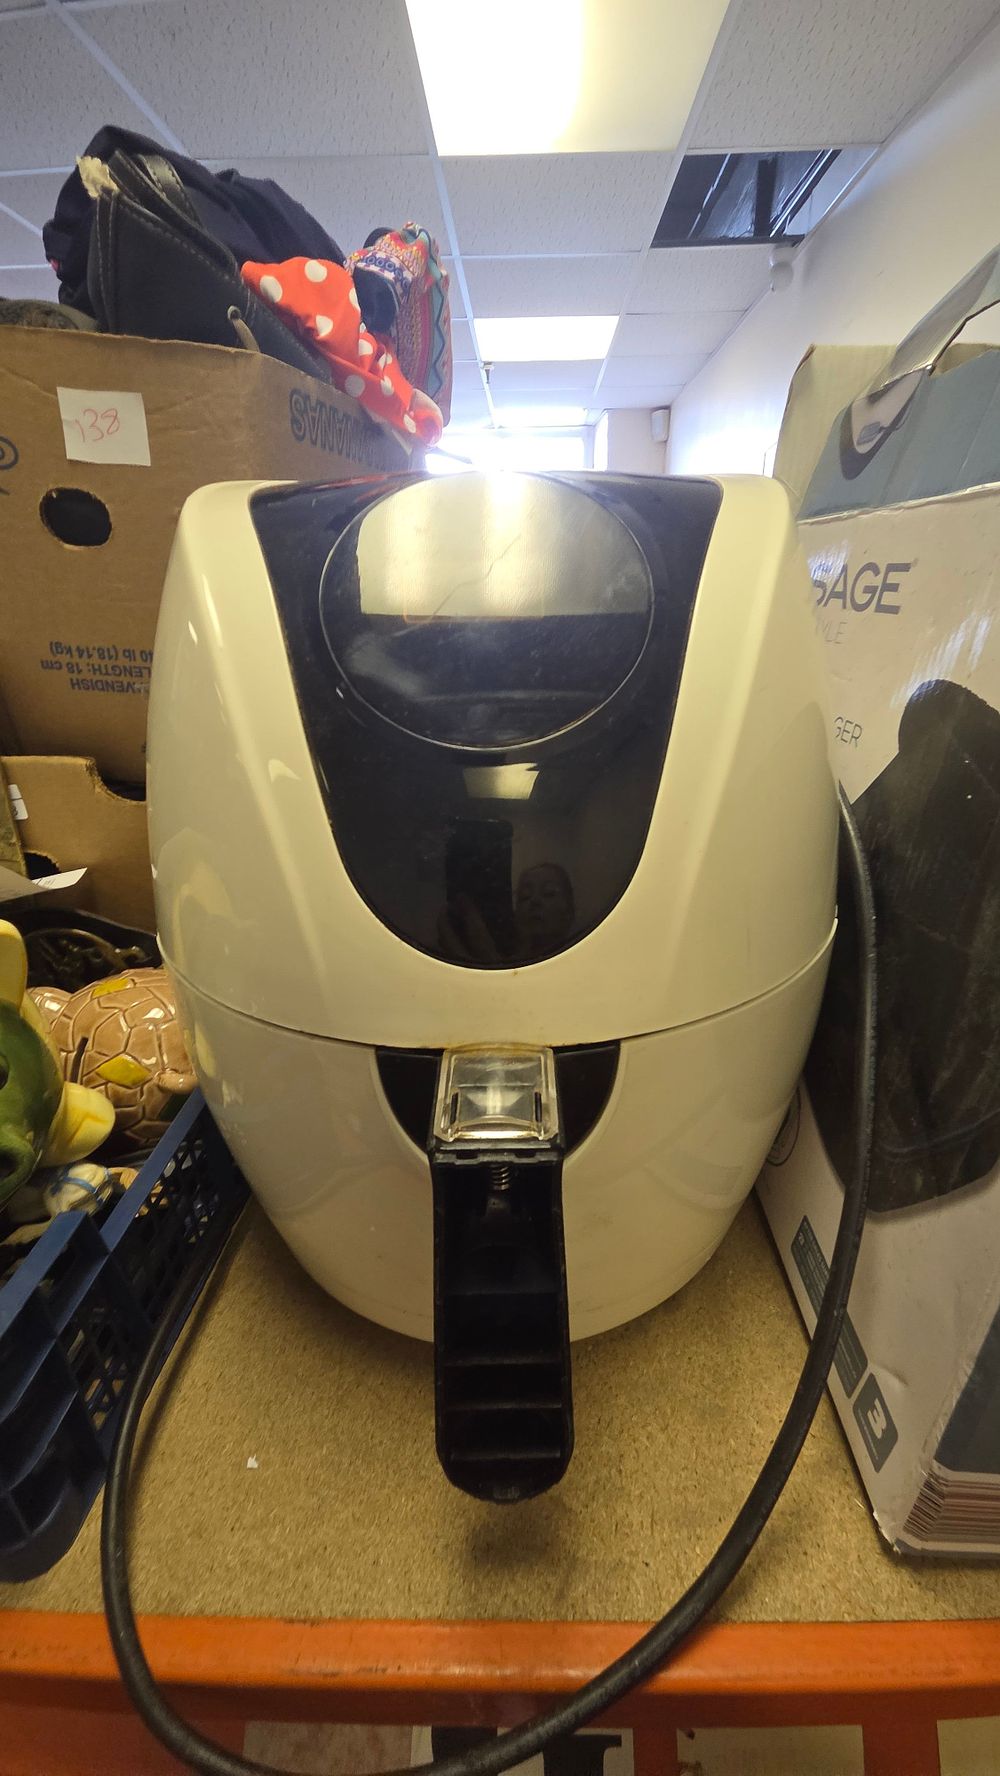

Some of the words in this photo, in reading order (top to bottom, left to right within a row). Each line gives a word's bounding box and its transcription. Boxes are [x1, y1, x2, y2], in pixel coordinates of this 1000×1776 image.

[74, 407, 120, 443] 138
[49, 640, 73, 658] kg)
[40, 659, 63, 671] cm
[66, 661, 82, 674] 18
[88, 663, 151, 679] LENGTH:
